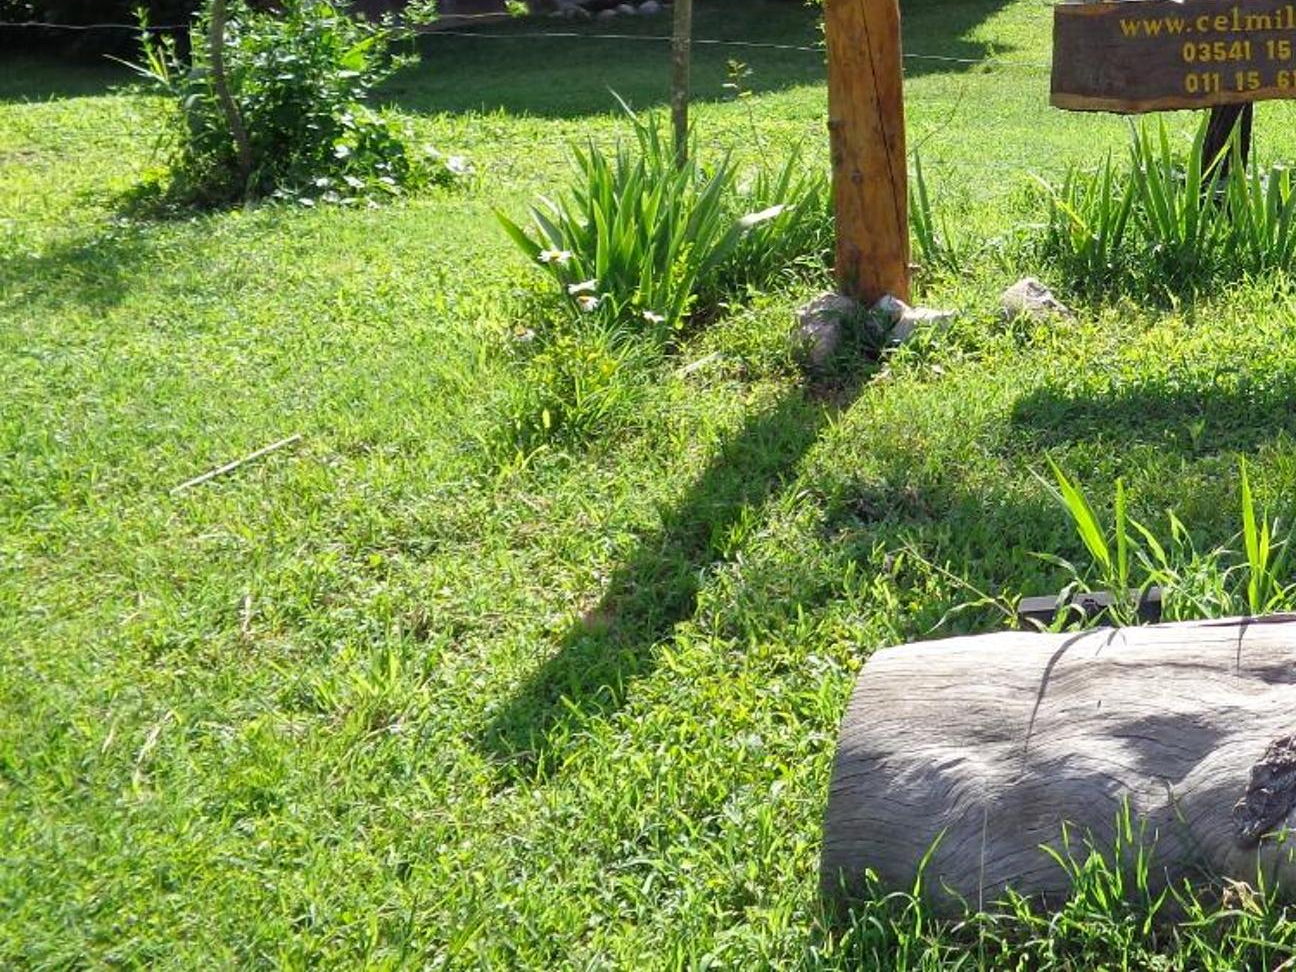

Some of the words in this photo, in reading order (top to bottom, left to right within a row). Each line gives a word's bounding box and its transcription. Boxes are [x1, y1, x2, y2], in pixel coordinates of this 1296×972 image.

[1182, 40, 1252, 63] 03541
[1266, 39, 1292, 60] 15
[1185, 71, 1221, 93] 011
[1235, 70, 1261, 91] 15
